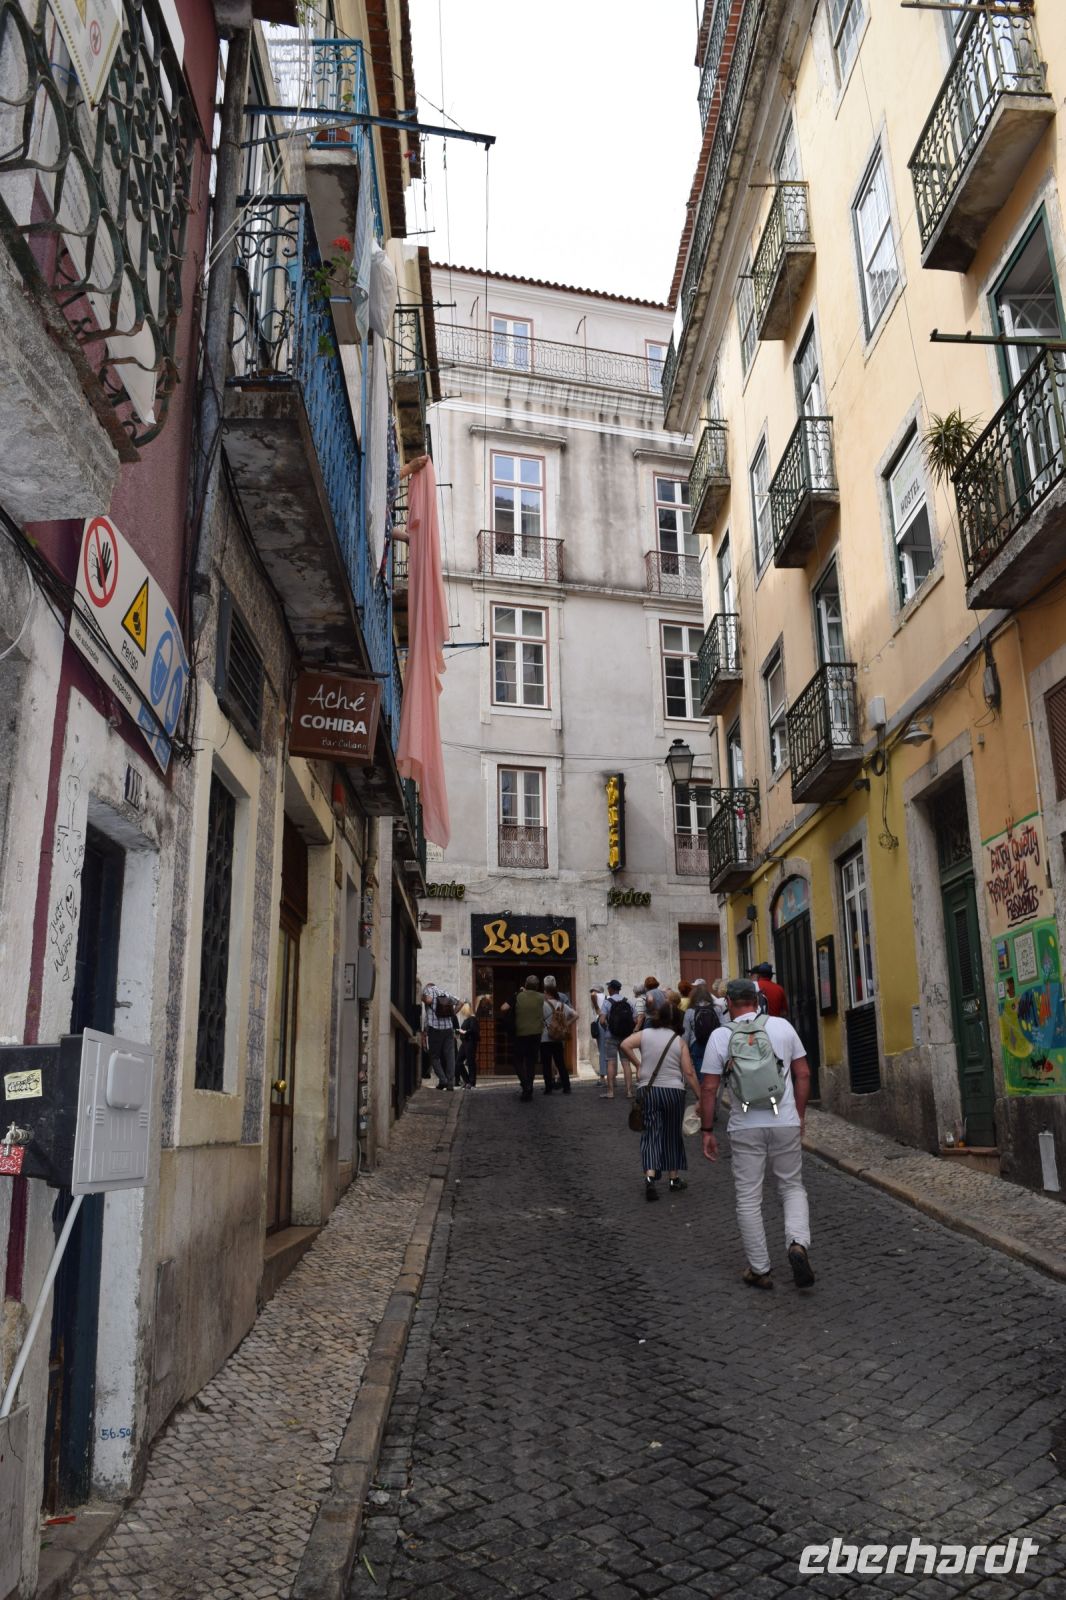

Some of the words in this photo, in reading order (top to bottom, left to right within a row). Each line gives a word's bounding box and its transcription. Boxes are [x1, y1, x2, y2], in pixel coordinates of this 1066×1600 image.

[899, 477, 921, 515] HOSTEL
[121, 639, 139, 672] Perigo
[307, 683, 366, 712] Aché
[300, 714, 367, 735] COHIBA
[483, 919, 571, 955] Luso
